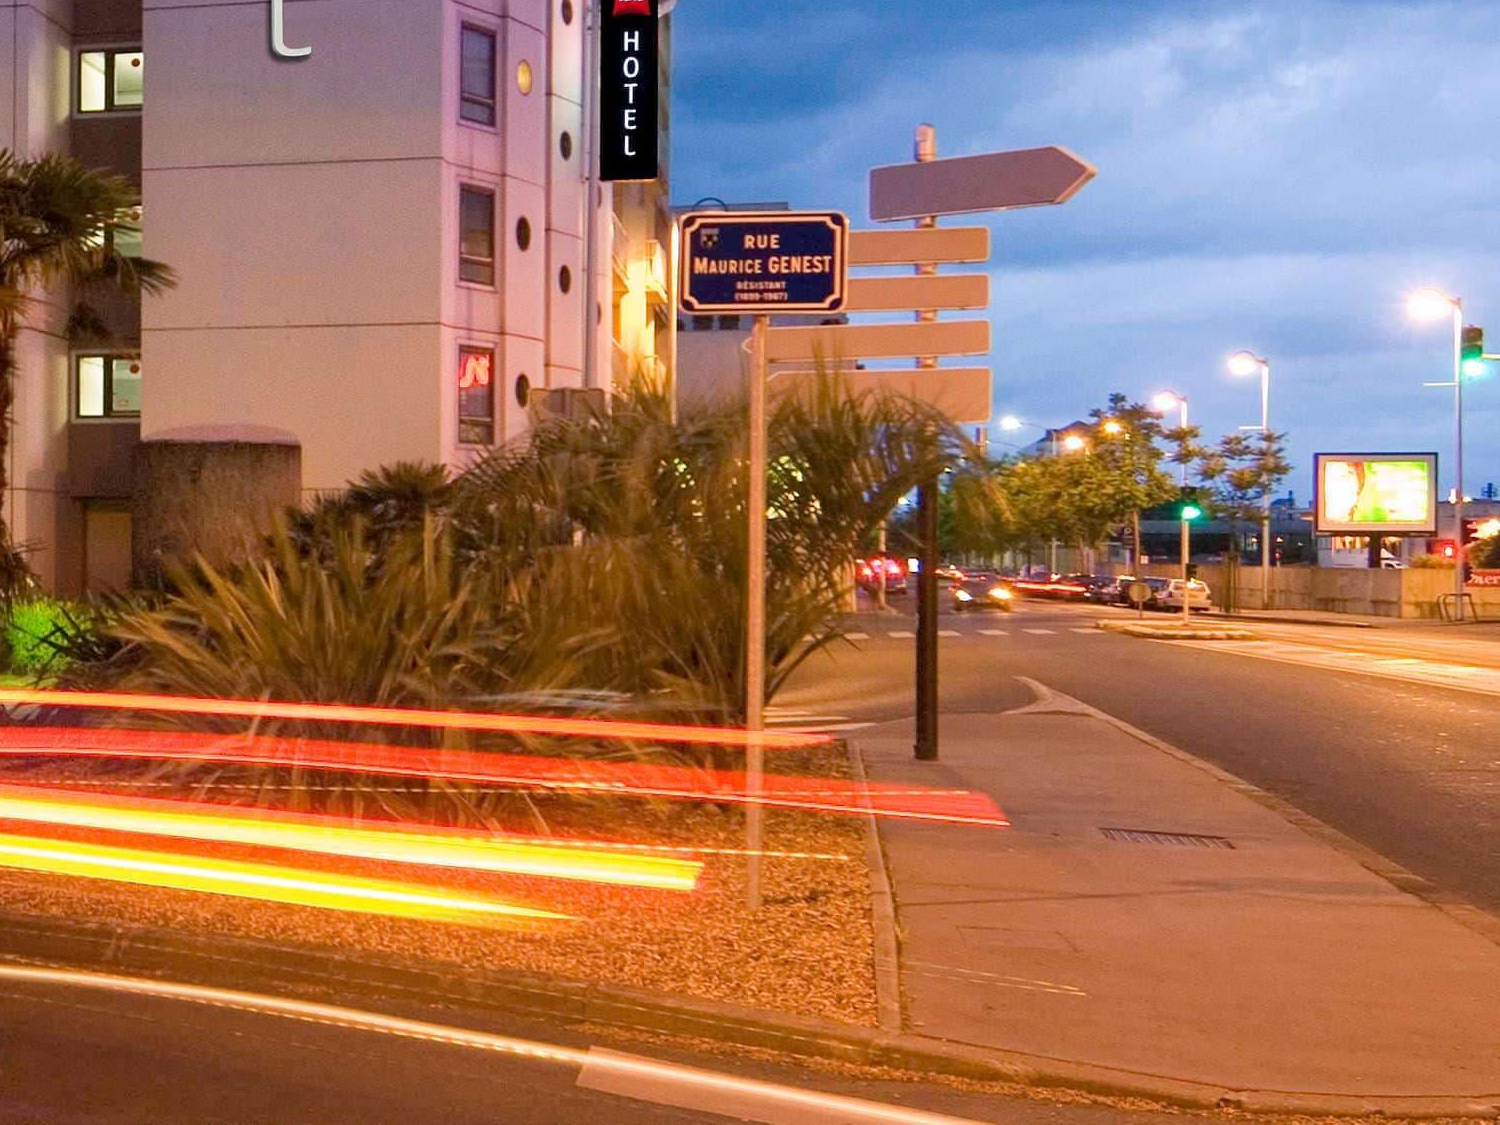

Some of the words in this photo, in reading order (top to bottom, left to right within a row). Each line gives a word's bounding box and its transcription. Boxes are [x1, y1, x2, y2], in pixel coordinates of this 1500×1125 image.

[622, 30, 639, 156] HOTEL
[744, 234, 780, 249] RUE
[693, 257, 762, 274] MAURICE
[767, 255, 832, 273] GENEST
